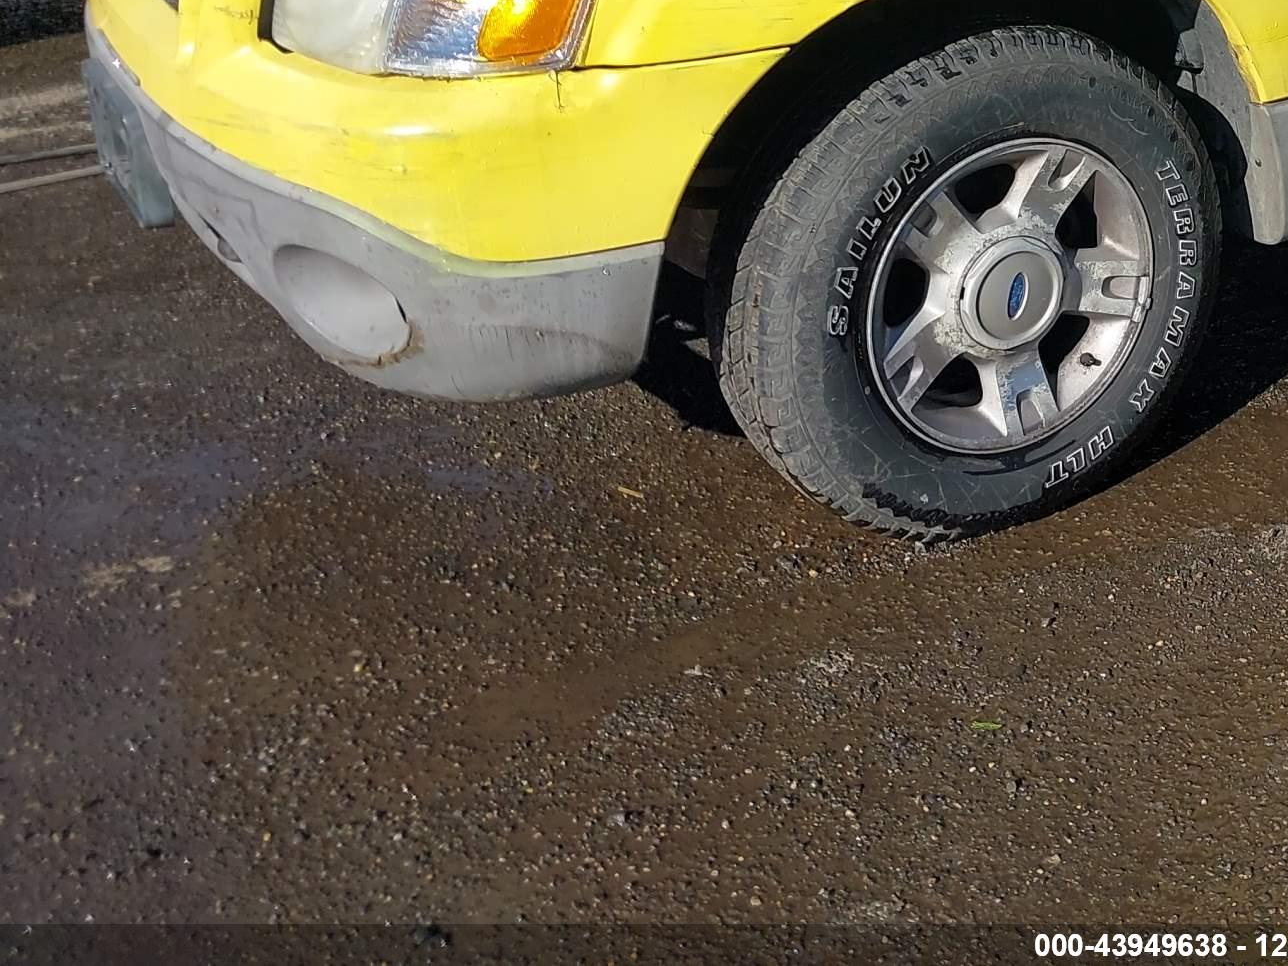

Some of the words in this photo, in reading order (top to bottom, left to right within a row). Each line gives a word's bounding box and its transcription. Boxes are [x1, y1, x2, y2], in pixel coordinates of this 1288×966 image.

[827, 145, 931, 336] SAILUN
[1129, 160, 1198, 413] TERRAMAX
[1045, 425, 1115, 488] HLT
